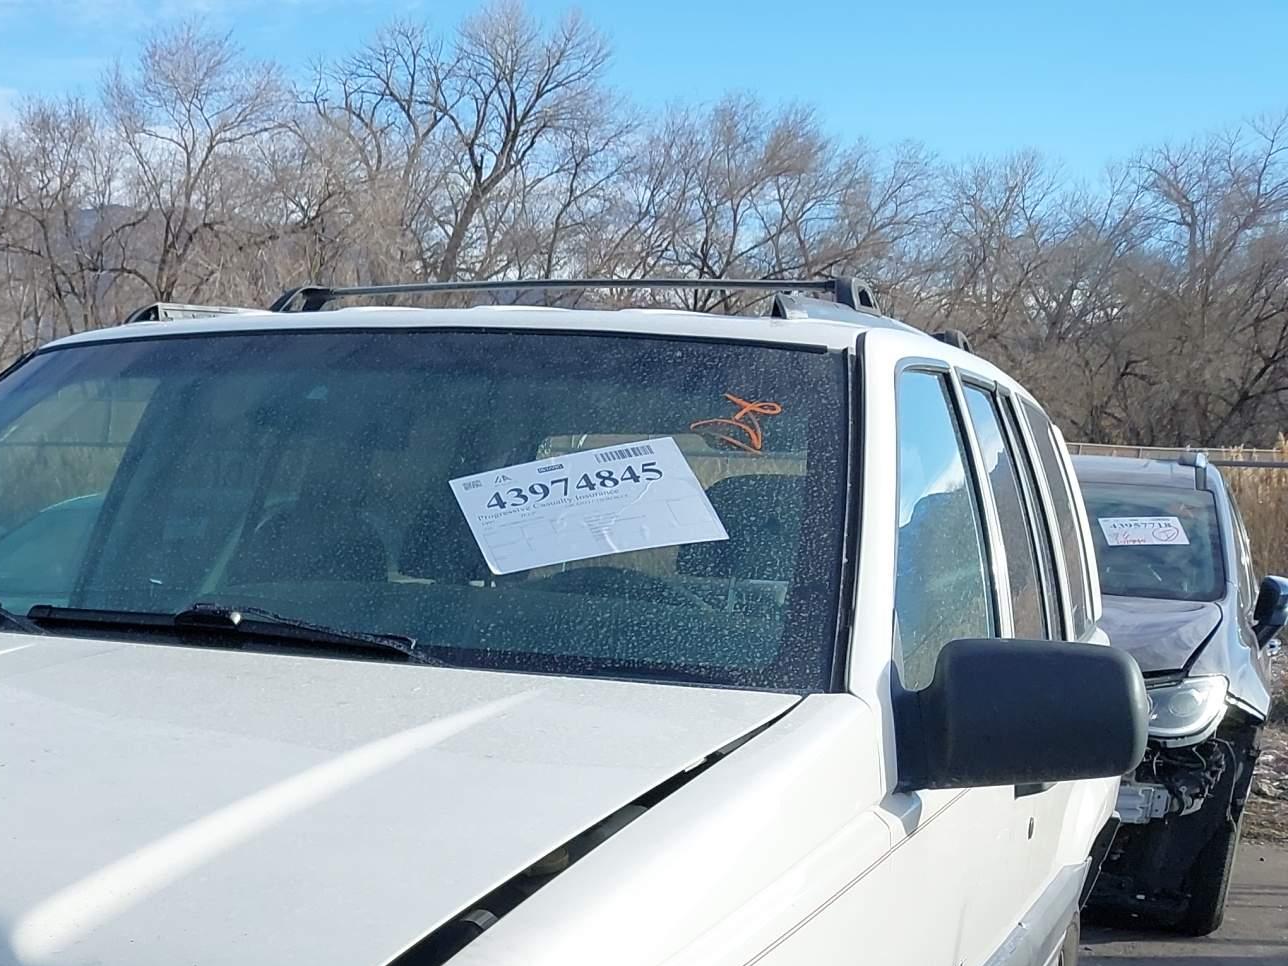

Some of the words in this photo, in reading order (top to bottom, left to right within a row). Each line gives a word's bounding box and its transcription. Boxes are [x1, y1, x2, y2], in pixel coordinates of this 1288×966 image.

[477, 503, 531, 522] Progressive
[574, 488, 620, 502] Insurance
[486, 461, 663, 510] 43974845
